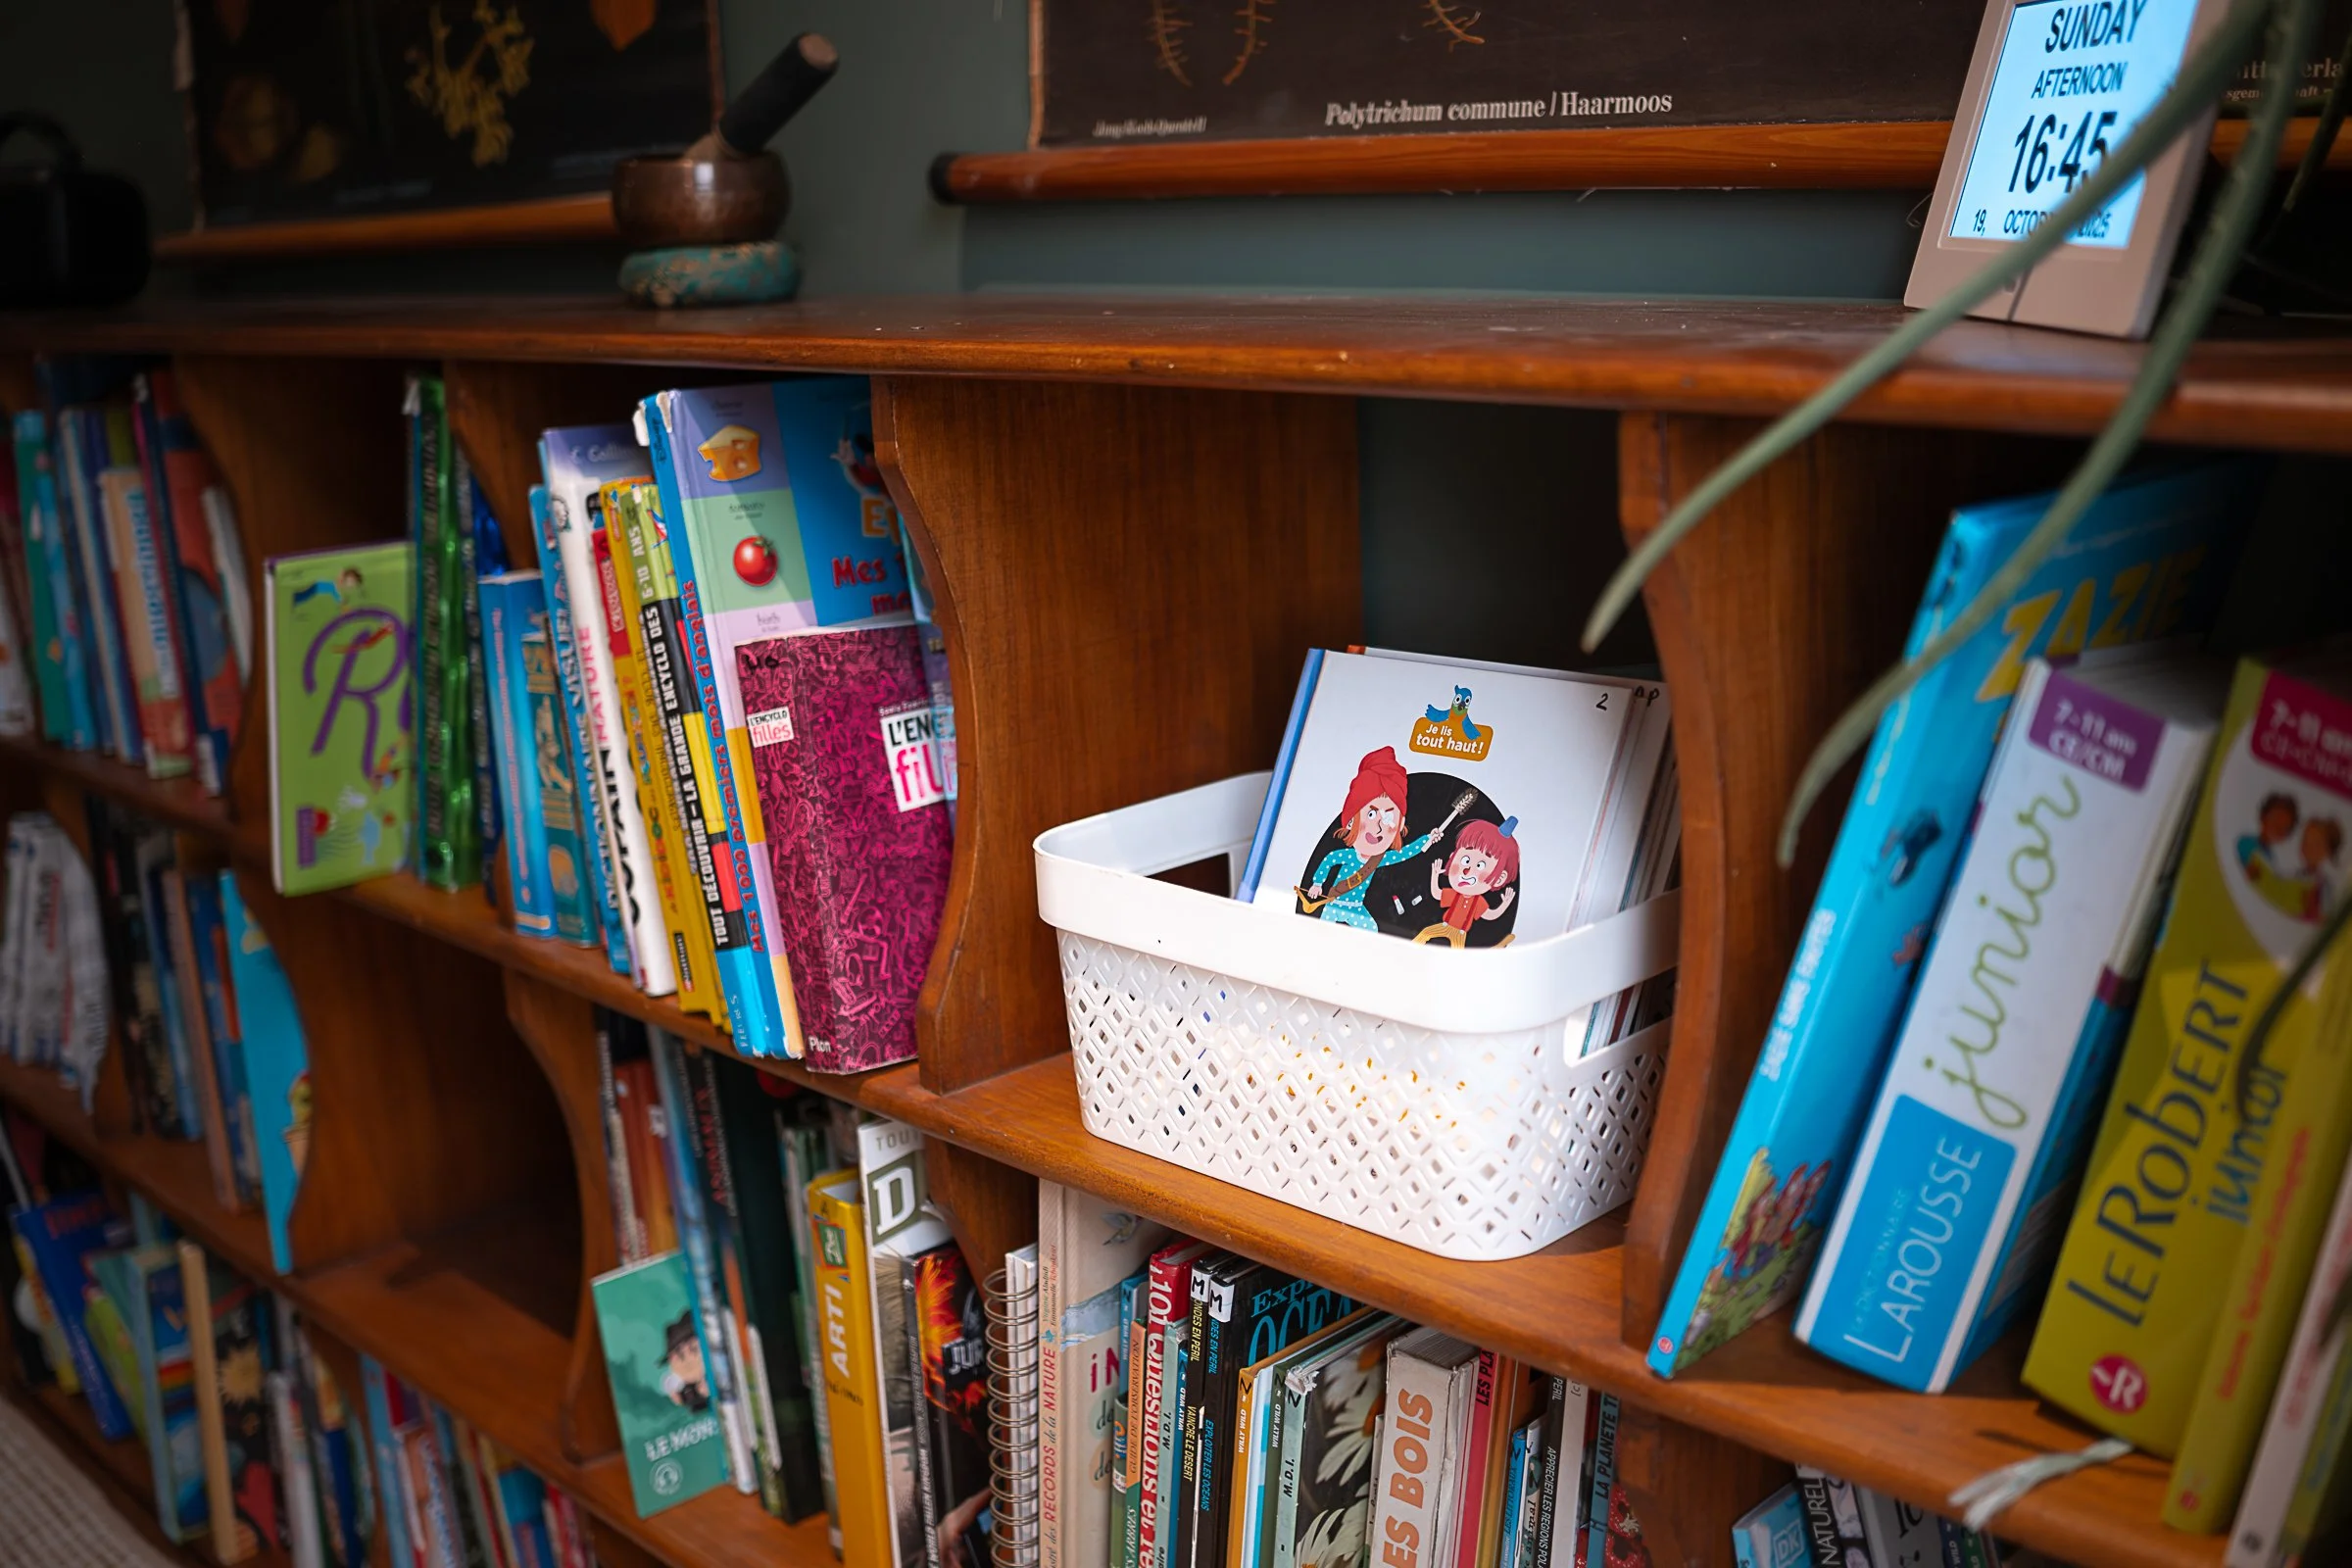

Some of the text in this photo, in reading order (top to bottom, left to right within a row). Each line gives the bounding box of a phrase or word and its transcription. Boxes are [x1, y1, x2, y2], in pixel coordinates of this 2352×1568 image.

[2045, 0, 2147, 53] SUNDAY
[2031, 62, 2129, 98] AFTERNOON
[1325, 99, 1443, 129] Polytrichum
[1446, 98, 1546, 120] commune
[1560, 91, 1672, 116] Haarmoos
[627, 525, 646, 558] ANS
[637, 565, 655, 599] 6-10
[645, 606, 663, 639] DES
[576, 626, 610, 742] NATURE
[653, 641, 679, 711] ENCYCLO
[749, 710, 788, 727] L'ENCYCLO
[753, 722, 792, 747] filles
[1426, 723, 1452, 736] Je lis
[668, 713, 693, 776] GRANDE
[1416, 732, 1445, 750] tout
[682, 579, 765, 954] Mes 1000 premiers mots d'anglais
[683, 780, 699, 803] LA
[691, 818, 720, 903] DÉCOUVRIR
[710, 907, 729, 947] TOUT
[1924, 774, 2082, 1131] junior
[808, 1035, 832, 1054] Plon
[875, 1129, 921, 1152] TOU
[1843, 1135, 1983, 1363] LAROUSSE
[1192, 1276, 1204, 1296] M
[1209, 1289, 1223, 1313] M
[824, 1282, 851, 1380] ARTI
[1210, 1339, 1219, 1349] EN
[1043, 1347, 1056, 1411] NATURE
[1208, 1350, 1218, 1375] PERIL
[1183, 1298, 1203, 1482] ONDES EN PERIL VAINCRE LE DESERT
[1475, 1379, 1491, 1407] LES
[1551, 1376, 1564, 1401] PERIL
[1042, 1414, 1056, 1429] la
[1043, 1430, 1056, 1444] de
[1131, 1424, 1140, 1438] DE
[1161, 1411, 1173, 1450] M.D.I.
[1204, 1419, 1214, 1462] EXPLOITER
[1238, 1431, 1247, 1454] WILLY
[1130, 1441, 1140, 1474] GUIDE
[1202, 1463, 1212, 1479] LES
[1544, 1446, 1557, 1494] APPRECIER
[1043, 1446, 1056, 1523] RECORDS
[1283, 1458, 1296, 1498] M.D.I.
[1383, 1388, 1434, 1568] ES BOIS
[1594, 1483, 1610, 1500] LA
[1200, 1480, 1212, 1512] OCEANS
[1542, 1495, 1552, 1512] LES
[1044, 1528, 1058, 1544] des
[1126, 1507, 1137, 1556] ARBRES
[1539, 1513, 1551, 1547] REGIONS
[1778, 1533, 1801, 1560] DK
